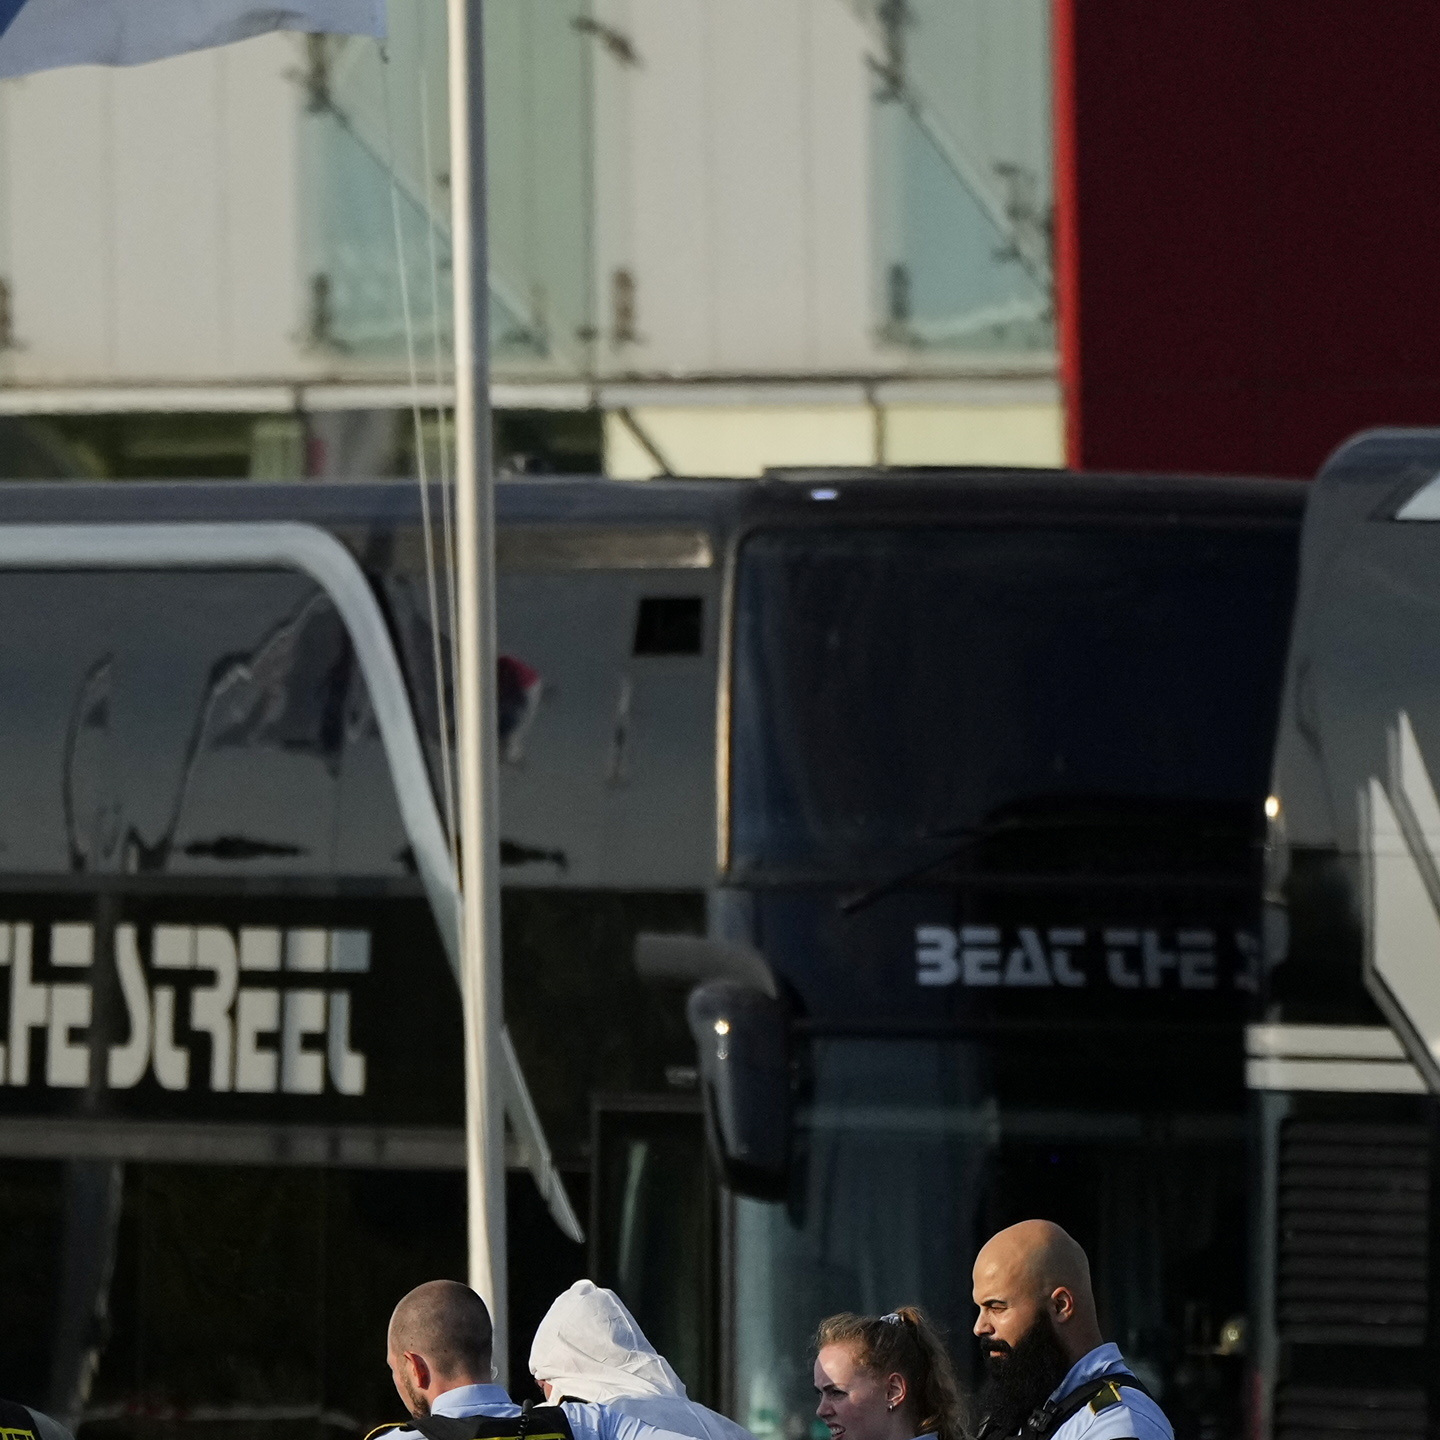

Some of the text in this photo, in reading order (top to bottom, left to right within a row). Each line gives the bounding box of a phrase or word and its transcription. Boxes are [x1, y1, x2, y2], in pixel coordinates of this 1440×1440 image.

[108, 923, 371, 1096] STREET
[915, 925, 1087, 987] BEAT
[1102, 927, 1216, 989] THE
